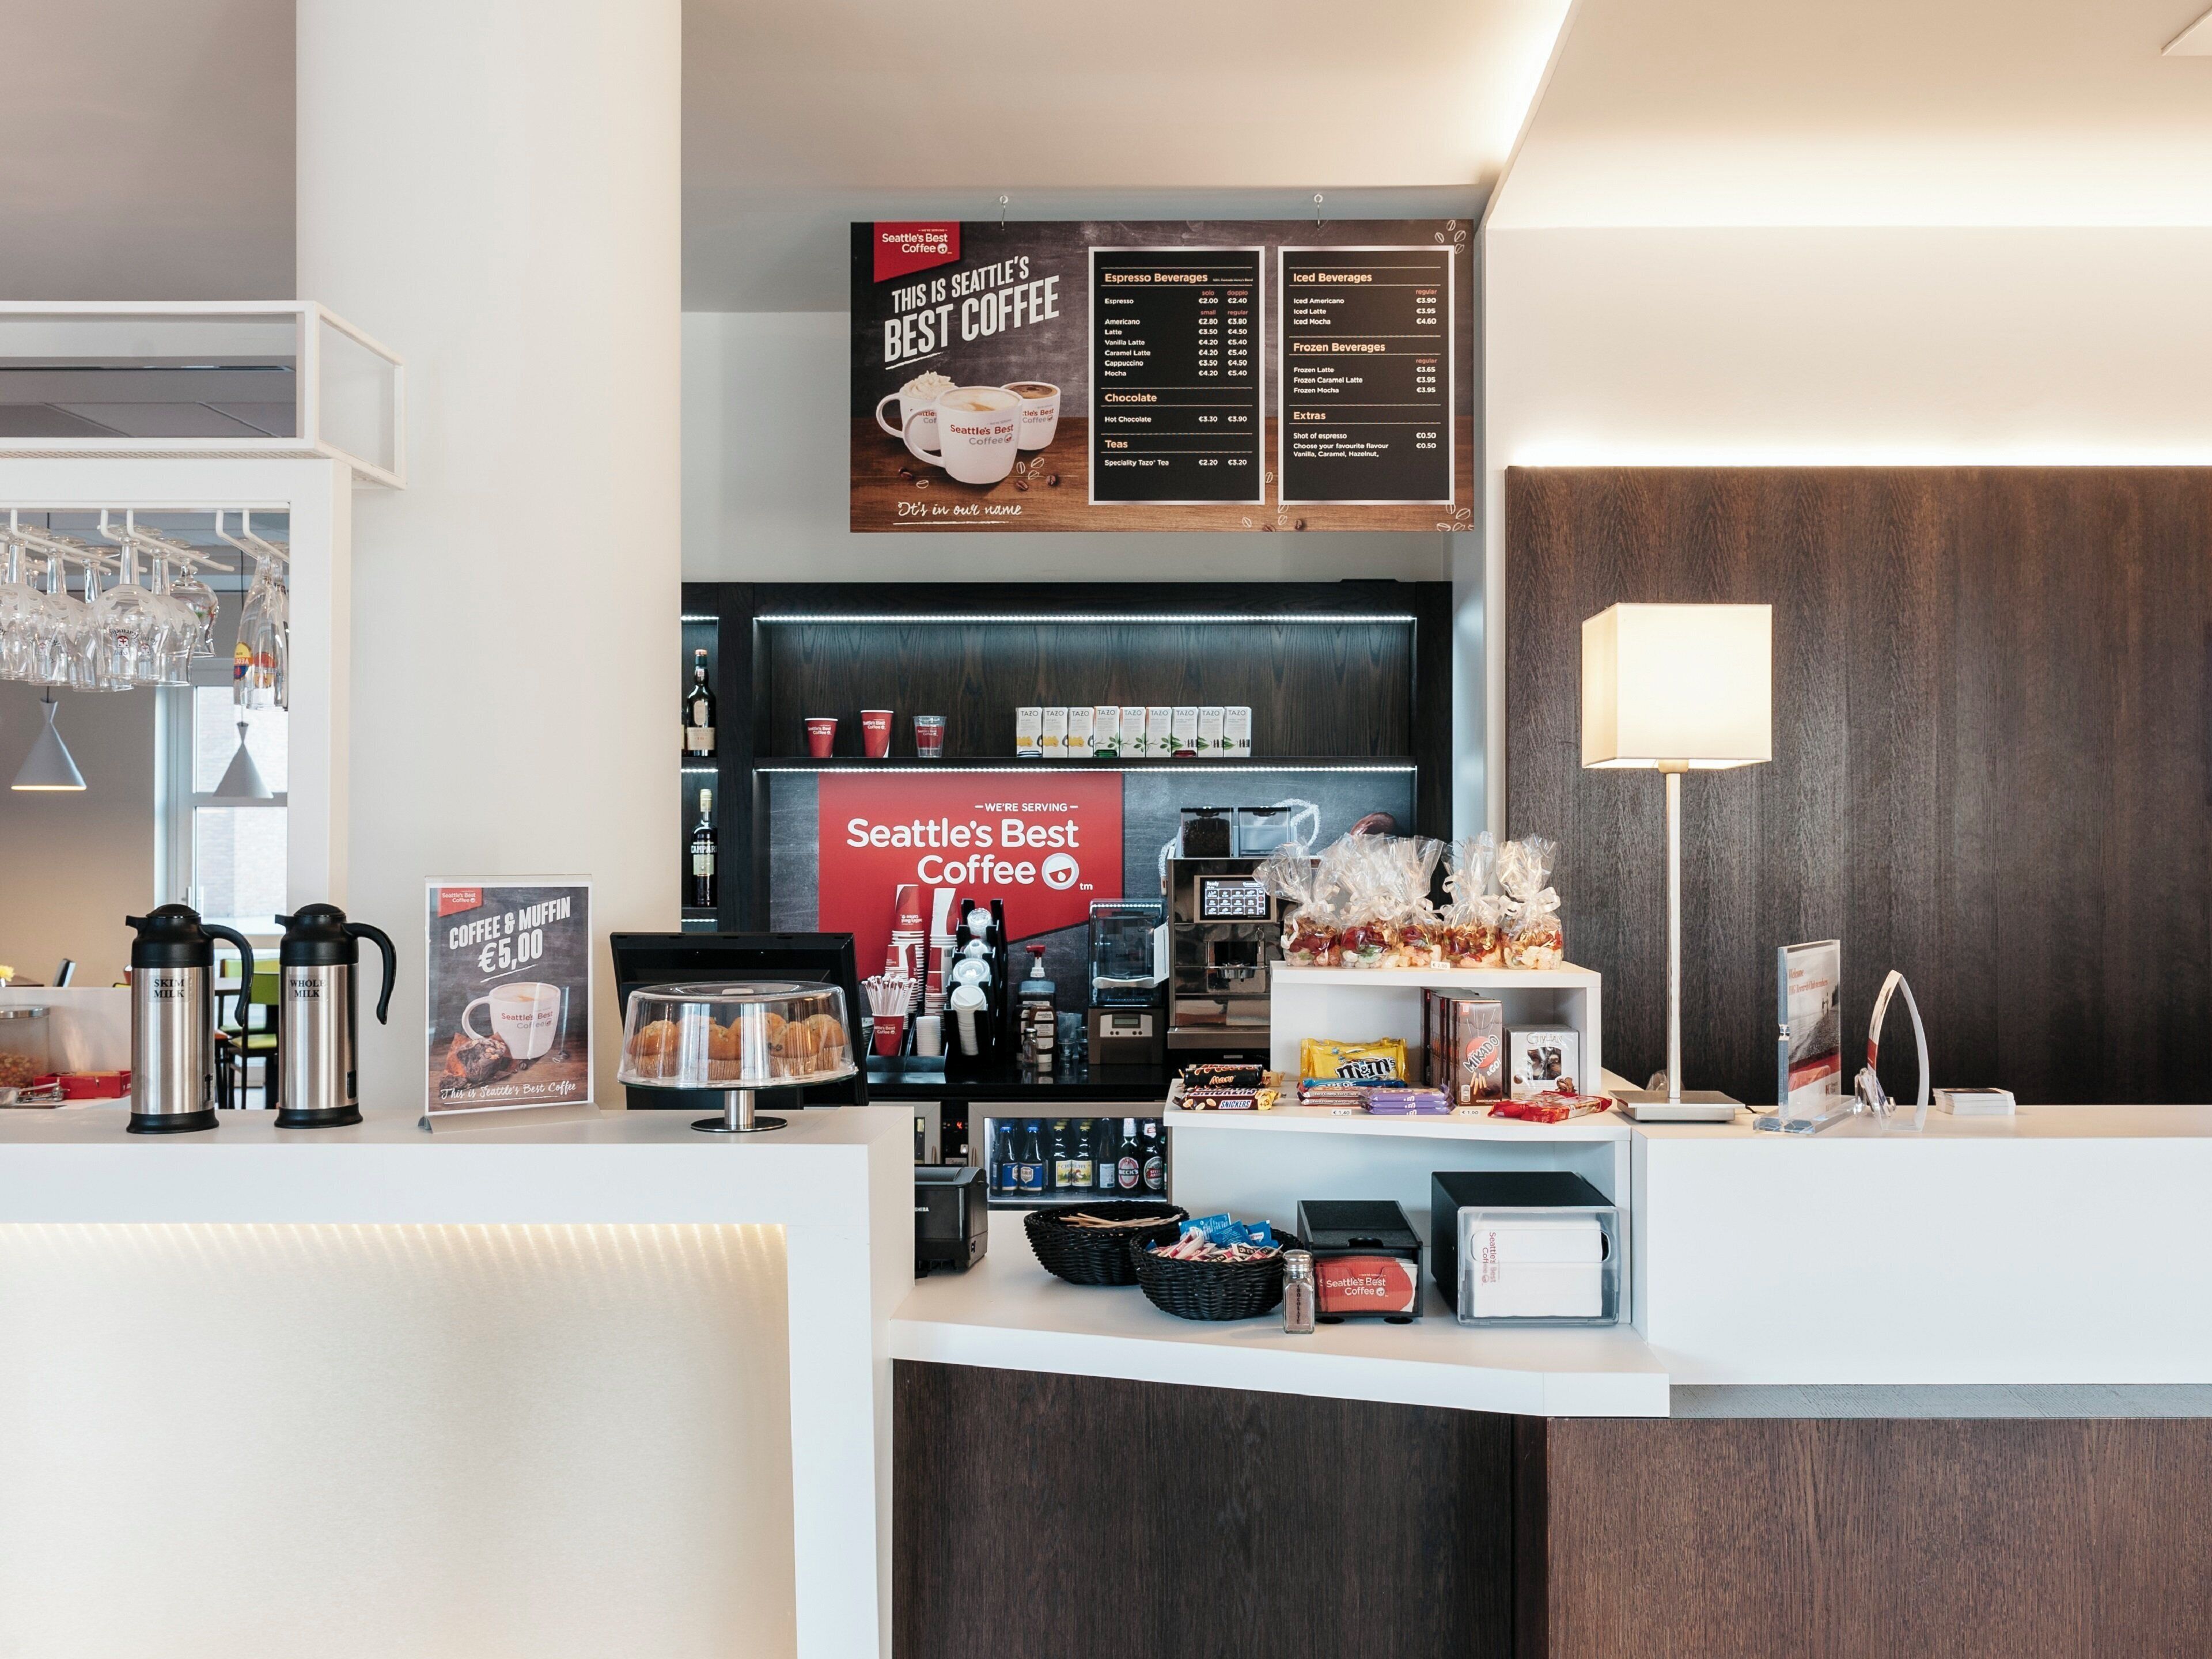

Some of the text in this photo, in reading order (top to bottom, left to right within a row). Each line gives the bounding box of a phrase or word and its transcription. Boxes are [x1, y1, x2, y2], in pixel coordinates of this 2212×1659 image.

[882, 233, 948, 243] Seattle's Best
[902, 243, 937, 253] Coffee
[1105, 273, 1208, 283] Espresso Beverages
[1293, 273, 1372, 283] Iced Beverages
[892, 256, 1029, 313] THIS IS SEATTLE'S
[884, 275, 1059, 362] BEST COFFEE
[1293, 342, 1385, 353] Frozen Beverages
[1105, 393, 1157, 402] Chocolate
[1293, 411, 1326, 420] Extras
[950, 423, 1014, 435] Seattle's Best
[968, 436, 1003, 445] Coffee
[1104, 440, 1128, 448] Teas
[897, 501, 1022, 517] It's in our name
[984, 802, 1068, 812] WE'RE SERVING
[846, 817, 1080, 848] Seattle's Best
[691, 845, 718, 854] CAMPARI
[917, 854, 1036, 884] Coffee
[1080, 882, 1093, 891] tm
[449, 896, 571, 950] COFFEE & MUFFIN
[478, 929, 543, 973] €5,00
[154, 979, 185, 987] SKIM
[290, 979, 326, 987] WHOLE
[153, 989, 185, 998] MILK
[294, 989, 320, 998] MILK
[501, 1010, 553, 1021] Seattle's Best
[516, 1020, 544, 1029] Coffee
[1463, 1035, 1500, 1073] MIKADO
[440, 1080, 577, 1100] This is Seattle's Best Coffee
[1220, 1100, 1251, 1109] SNICKERS
[1326, 1277, 1387, 1288] Seattle's Best
[1344, 1287, 1375, 1296] Coffee
